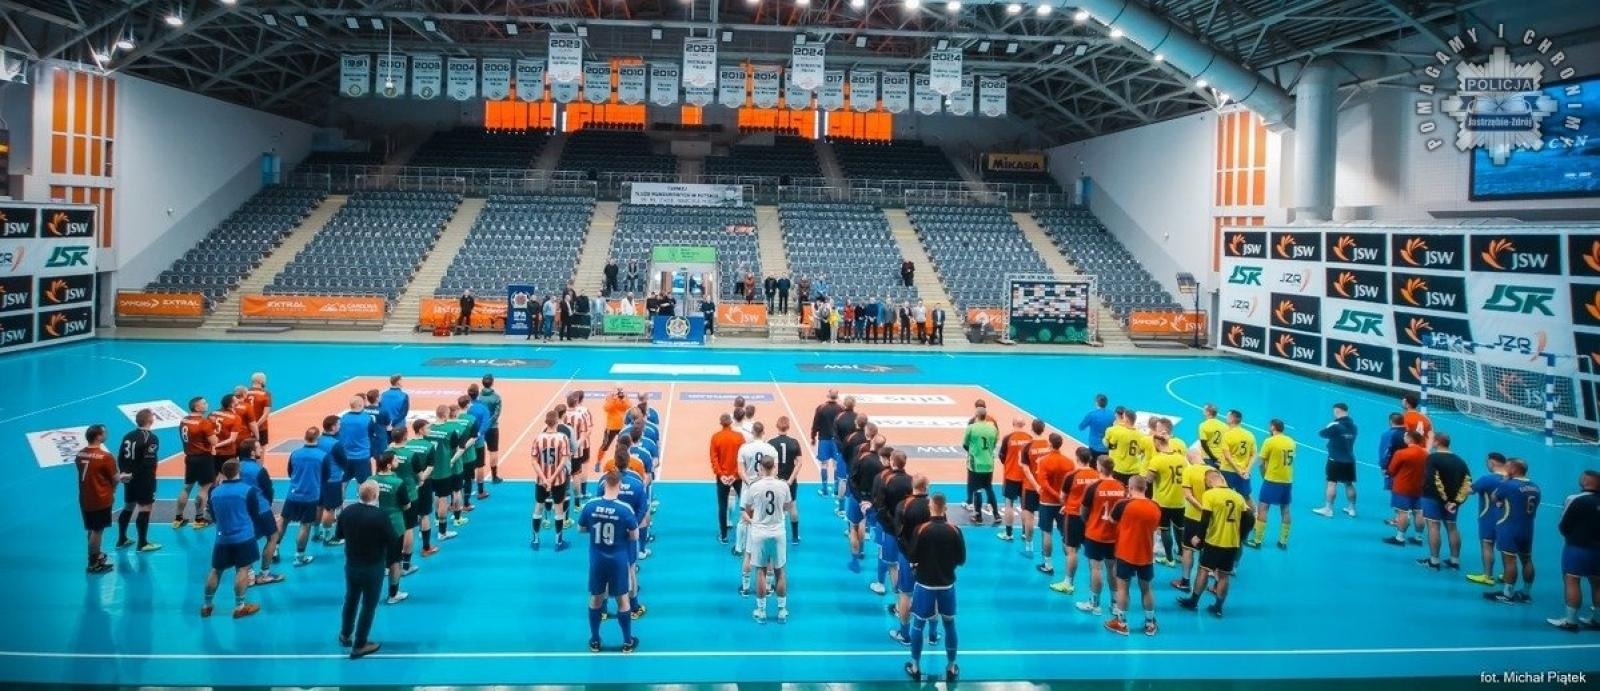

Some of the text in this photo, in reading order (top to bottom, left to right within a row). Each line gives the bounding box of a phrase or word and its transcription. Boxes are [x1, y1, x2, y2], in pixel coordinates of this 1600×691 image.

[551, 40, 580, 48] 2023
[686, 44, 714, 52] 2023
[794, 48, 823, 56] 2024
[4, 222, 29, 236] JSW
[66, 222, 89, 235] JSW
[1243, 244, 1262, 255] JSW
[1293, 246, 1315, 258] JSW
[1352, 248, 1378, 261] JSW
[1424, 251, 1454, 266] JSW
[1512, 253, 1548, 270] JSW
[65, 288, 86, 301] JSW
[1353, 284, 1379, 298] JSW
[3, 292, 29, 309] JSW
[1425, 291, 1456, 307] JSW
[1482, 284, 1556, 316] JSK
[1292, 311, 1315, 325] JSW
[64, 320, 87, 335] JSW
[1, 329, 26, 344] JSW
[1241, 337, 1260, 348] JSW
[1292, 347, 1315, 360] JSW
[1356, 358, 1384, 372] JSW
[182, 425, 189, 442] 8
[1214, 431, 1222, 444] 2
[124, 439, 137, 460] 31
[780, 443, 787, 463] 1
[1128, 440, 1137, 456] 6
[1240, 441, 1247, 456] 3
[543, 448, 555, 464] 15
[1282, 449, 1293, 466] 15
[81, 460, 89, 481] 7
[765, 490, 775, 515] 3
[1226, 500, 1236, 522] 2
[592, 522, 615, 546] 19
